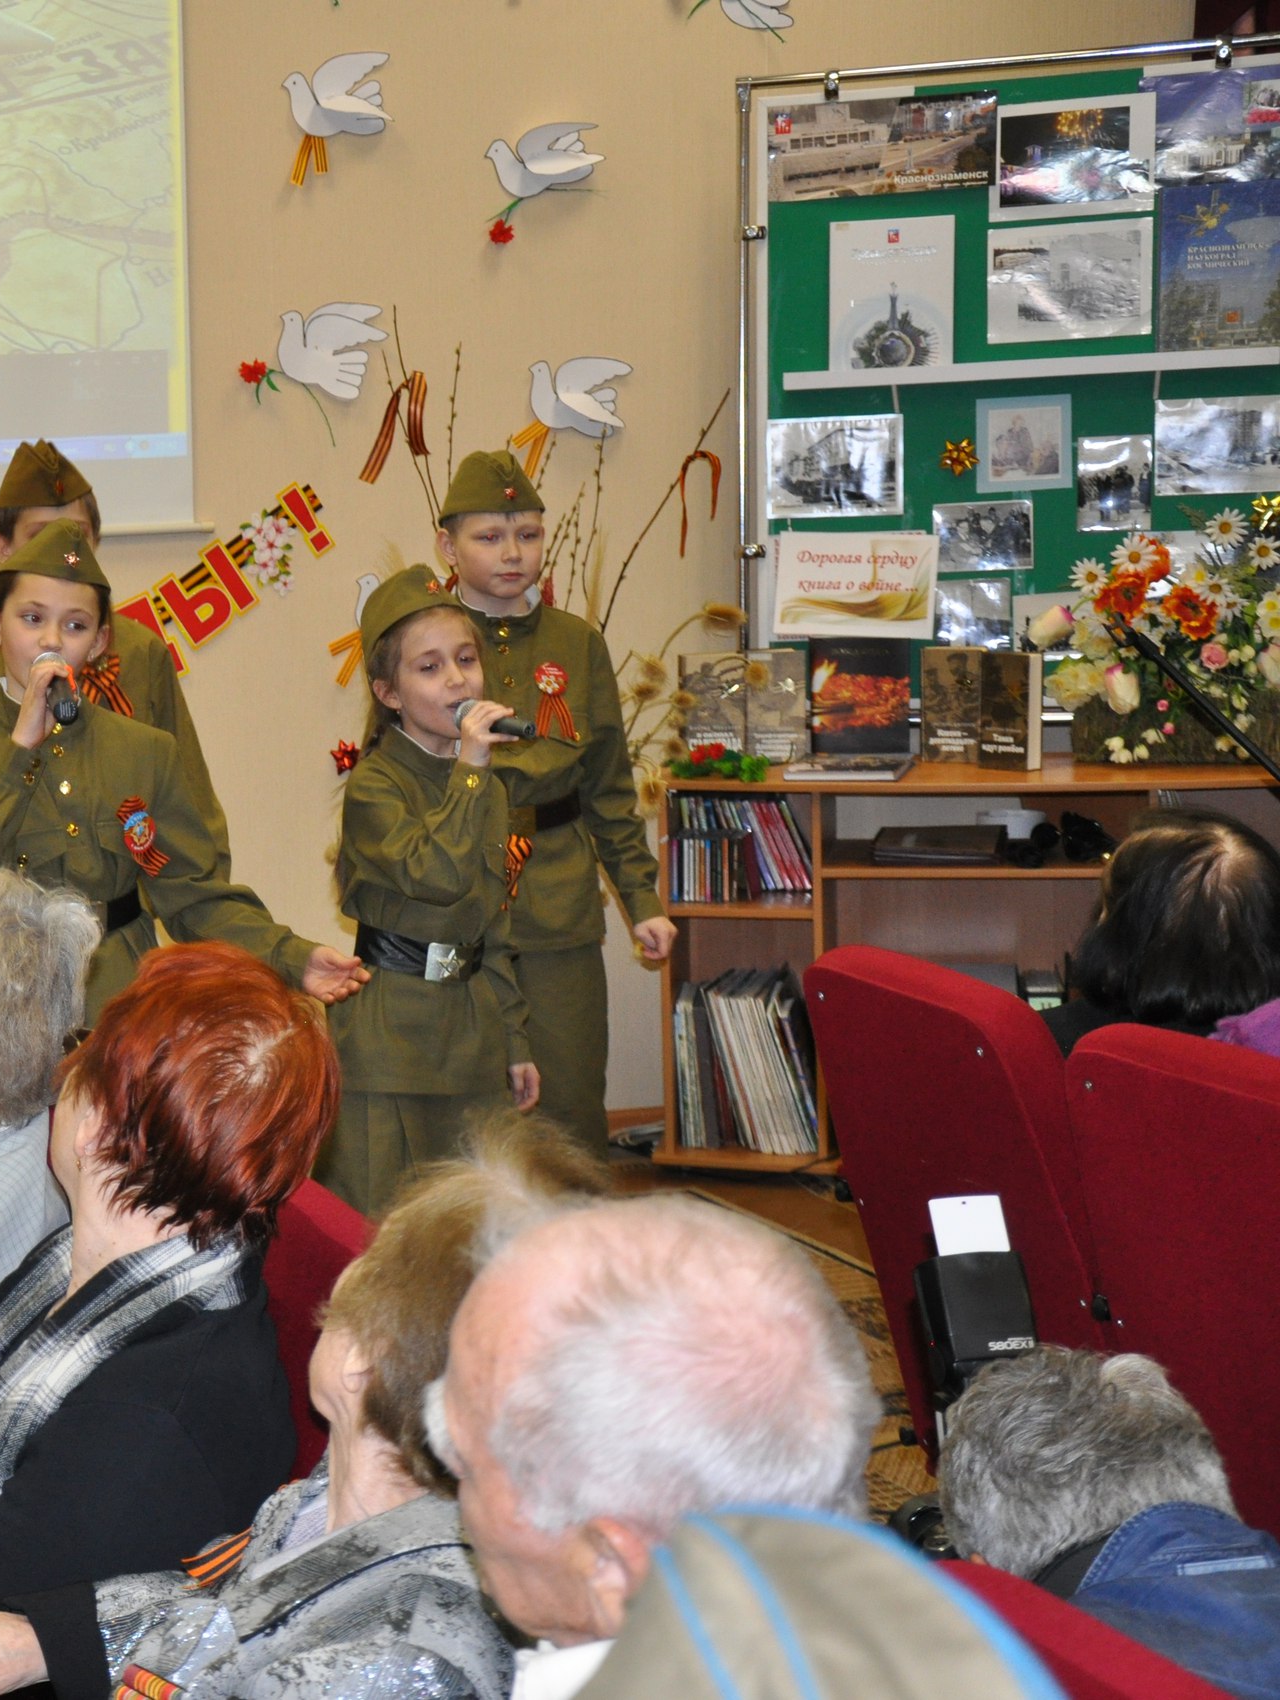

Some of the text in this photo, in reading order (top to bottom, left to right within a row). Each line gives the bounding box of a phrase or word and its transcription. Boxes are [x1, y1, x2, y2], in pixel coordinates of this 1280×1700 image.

[894, 170, 989, 185] Краснознаменск
[797, 550, 918, 569] Дорогая сердцу
[798, 580, 841, 593] книга
[846, 582, 855, 591] о
[859, 580, 902, 592] войне
